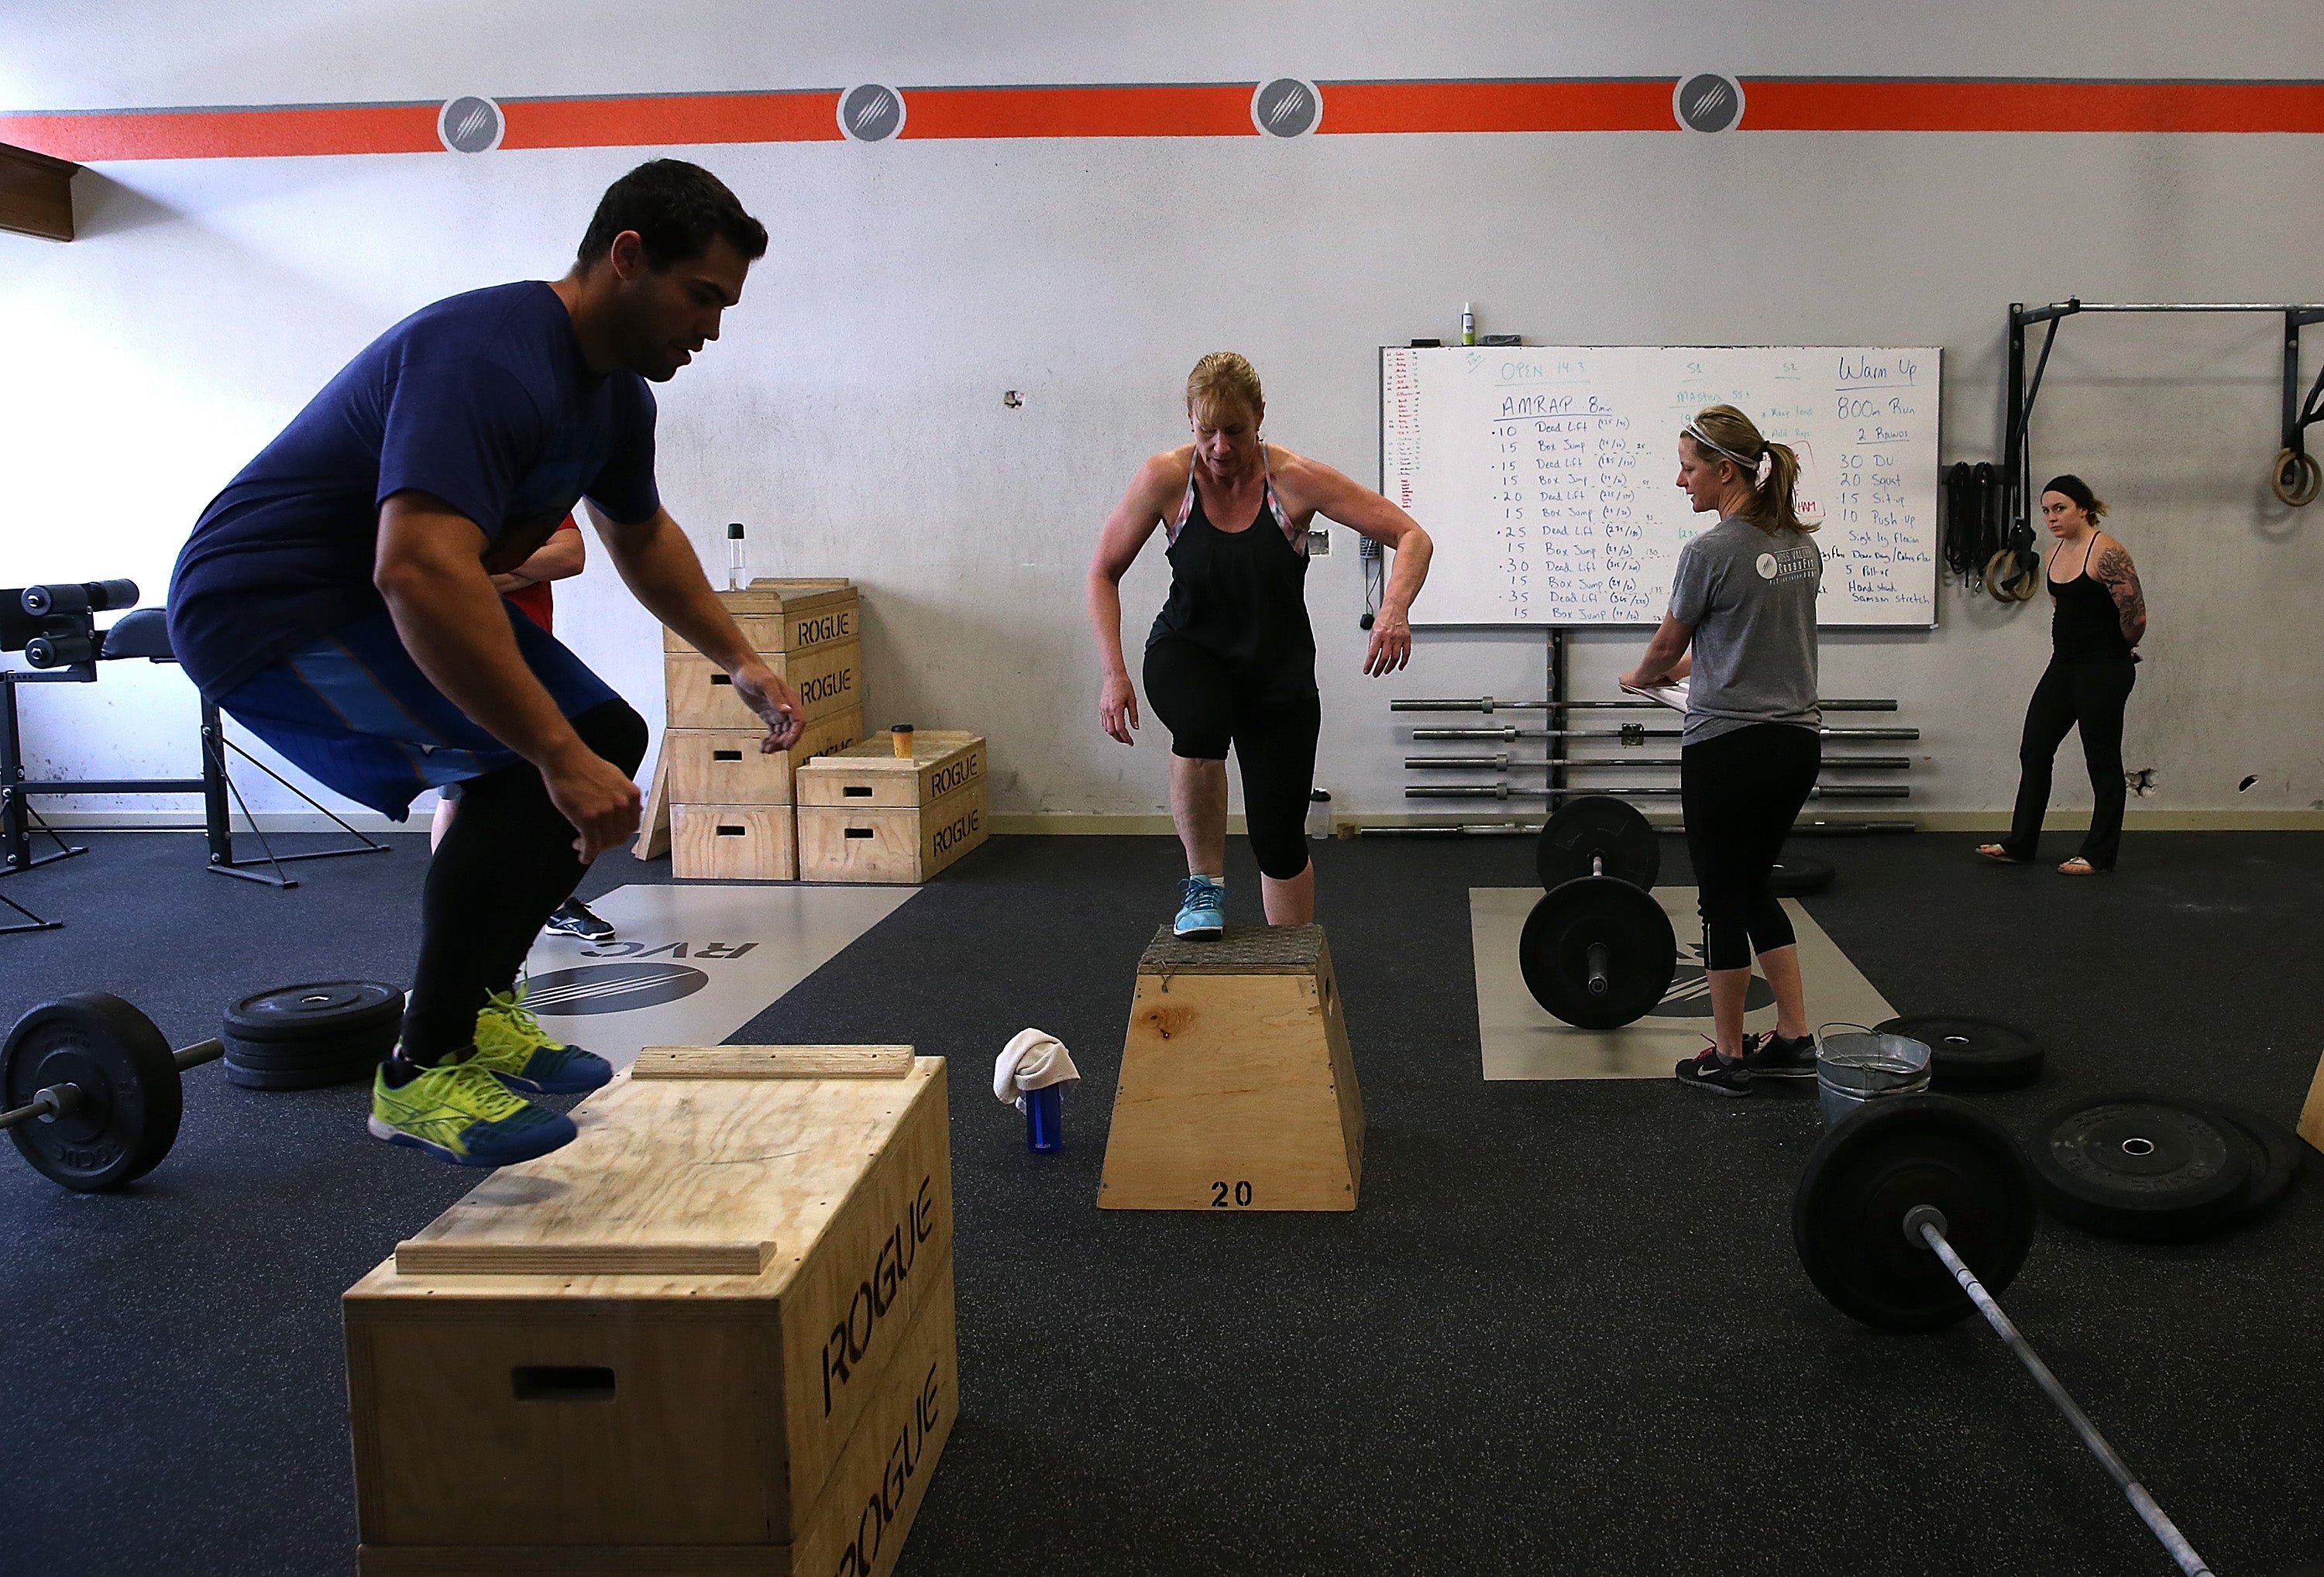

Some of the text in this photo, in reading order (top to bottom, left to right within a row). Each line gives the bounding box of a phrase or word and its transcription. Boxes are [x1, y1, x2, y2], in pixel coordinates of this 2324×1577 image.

[1501, 362, 1543, 380] OPEN
[1839, 356, 1917, 386] Warm Up
[1502, 395, 1573, 416] AMRAP
[1889, 397, 1915, 414] Run
[1535, 421, 1561, 432] Dead
[1859, 428, 1866, 441] 2
[1501, 441, 1518, 452] 15
[1538, 440, 1556, 451] Box
[1563, 441, 1586, 453] Jump
[1502, 461, 1516, 471] 15
[1536, 459, 1561, 469] Dead
[1840, 454, 1863, 469] 30
[1503, 476, 1518, 486] 15
[1538, 475, 1559, 485] Box
[1841, 472, 1901, 493] 20 Squat
[1504, 491, 1522, 501] 20
[1540, 492, 1563, 501] Dead
[1841, 493, 1859, 503] 15
[1506, 507, 1523, 519] 15
[1542, 507, 1561, 517] Box
[1843, 509, 1858, 523] 10
[1506, 527, 1526, 538] 25
[1542, 526, 1569, 536] Dead
[1508, 542, 1525, 552] 15
[1545, 542, 1569, 556] Box
[1574, 545, 1597, 559] Jump
[1508, 558, 1529, 572] 30
[1545, 561, 1573, 572] Dead
[1846, 565, 1852, 575] 5
[1511, 575, 1527, 585] 15
[1549, 576, 1572, 589] Box
[1579, 579, 1603, 593] Jump
[1508, 590, 1528, 603] 35
[1549, 591, 1577, 603] Dead
[1514, 608, 1528, 618] 15
[1552, 607, 1573, 619] Box
[1580, 609, 1606, 622] Jump
[798, 613, 849, 646] ROGUE
[800, 668, 851, 706] ROGUE
[931, 754, 978, 798] ROGUE
[933, 809, 979, 858] ROGUE
[580, 942, 759, 958] RVC
[1211, 1180, 1253, 1208] 20
[823, 1175, 933, 1419] ROGUE
